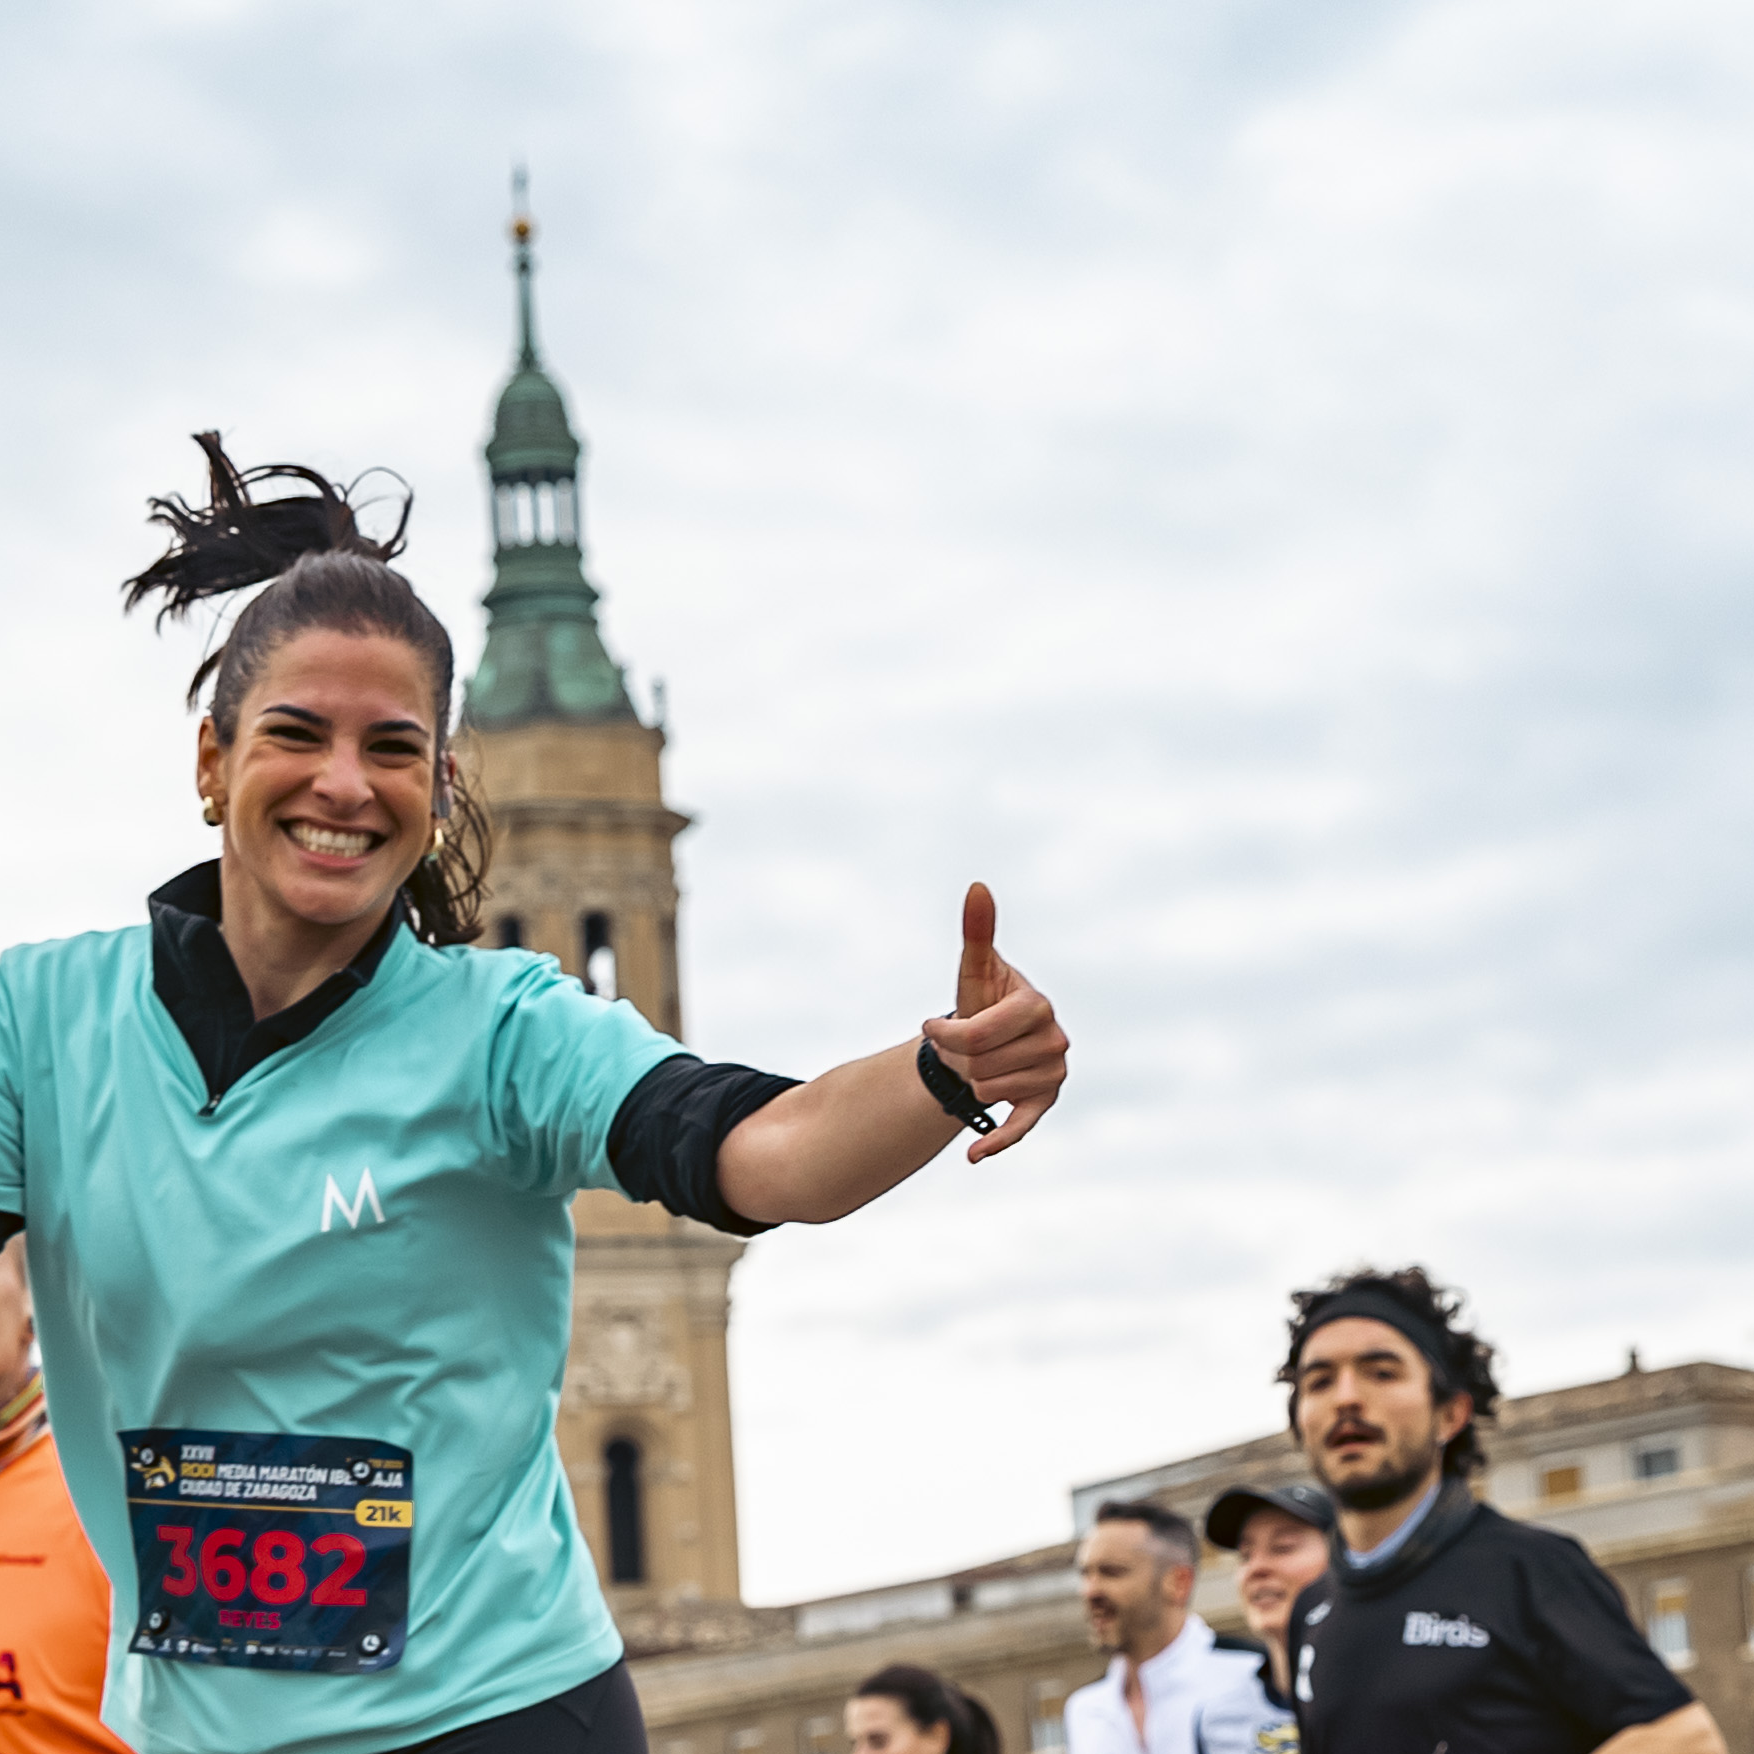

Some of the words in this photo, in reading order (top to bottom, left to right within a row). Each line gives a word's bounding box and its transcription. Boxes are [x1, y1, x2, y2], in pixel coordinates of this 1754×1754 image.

[320, 1166, 386, 1233] M
[217, 1463, 256, 1480] MEDIA
[258, 1464, 328, 1485] MARATÓN
[224, 1481, 242, 1498] DE
[243, 1481, 317, 1501] ZARAGOZA
[365, 1505, 402, 1522] 21k
[157, 1525, 367, 1606] 3682
[219, 1609, 281, 1630] REYES
